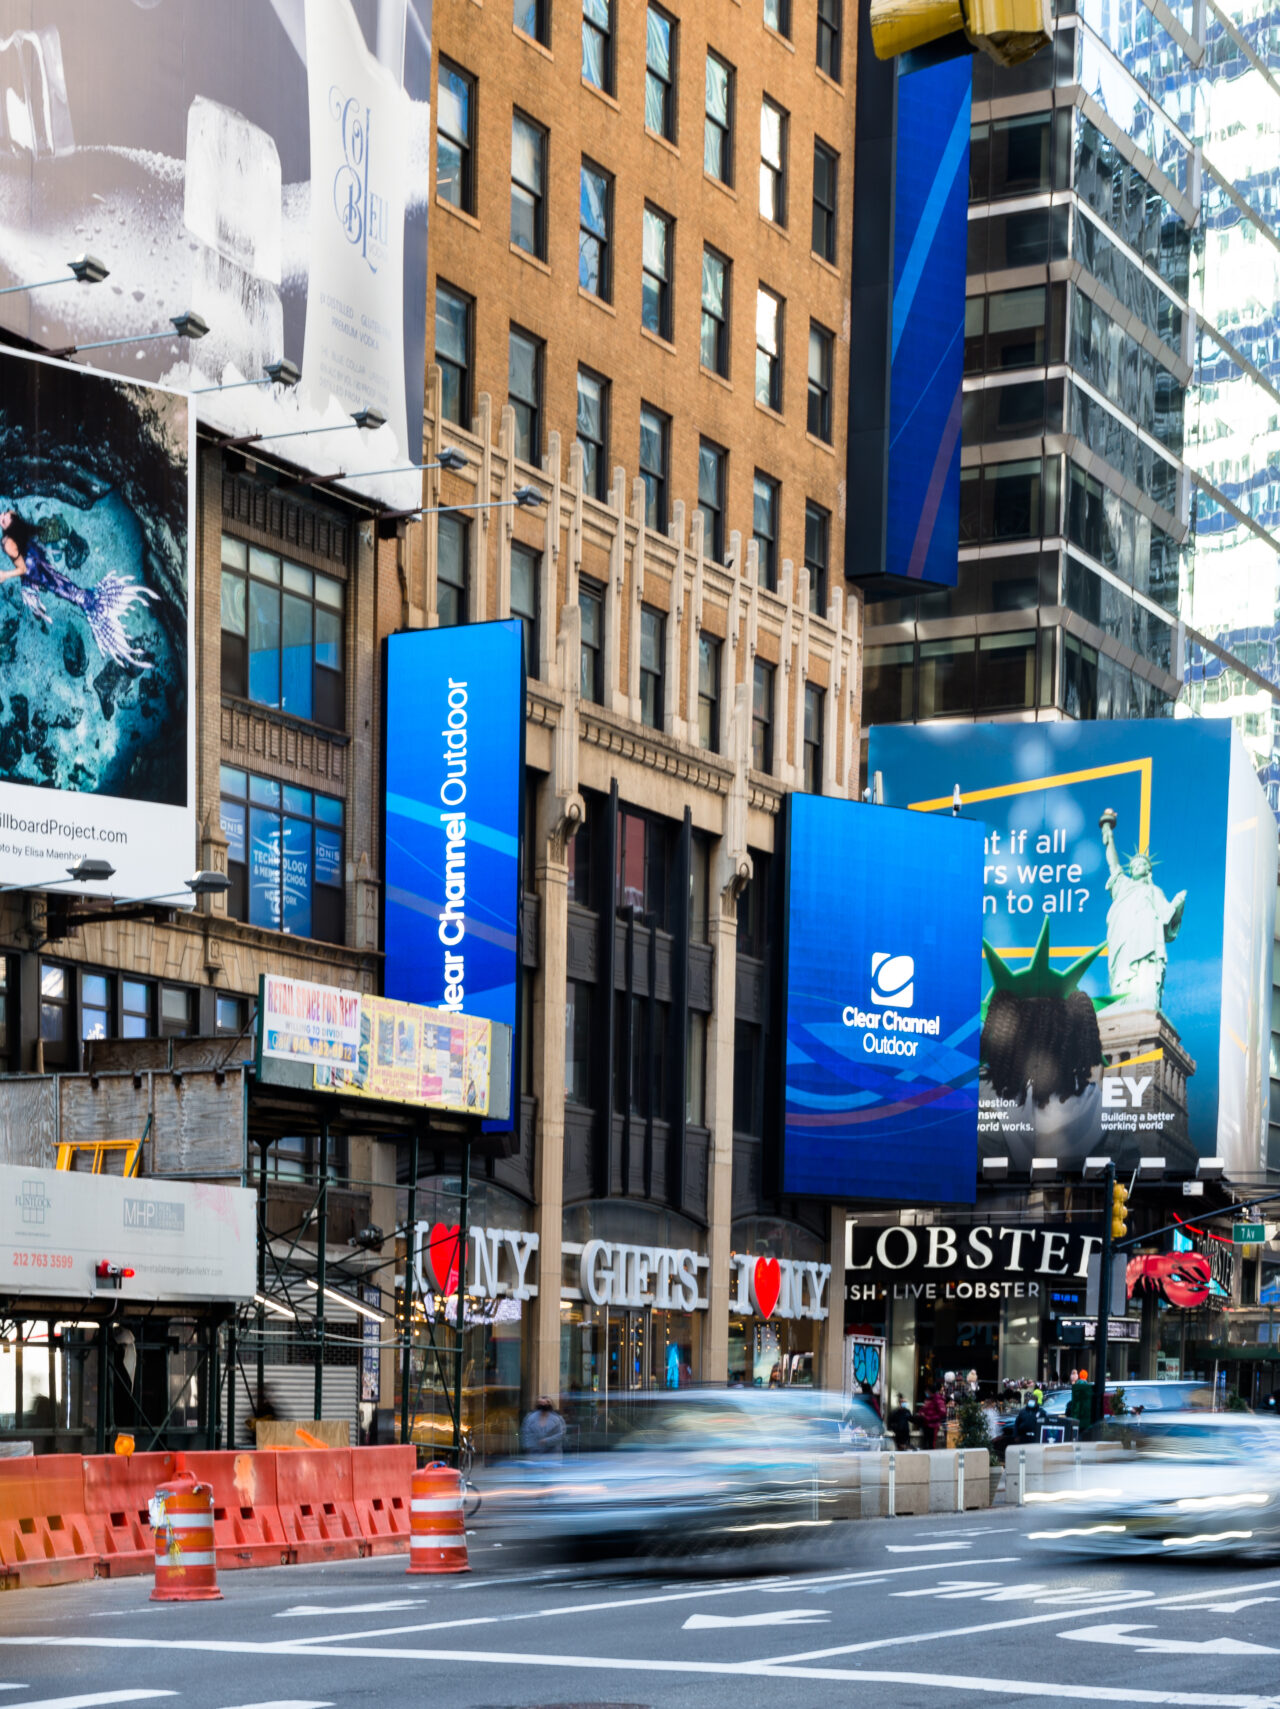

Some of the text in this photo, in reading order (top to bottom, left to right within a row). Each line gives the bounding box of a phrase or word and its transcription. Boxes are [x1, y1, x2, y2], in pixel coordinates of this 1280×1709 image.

[440, 677, 468, 806] Outdoor
[12, 844, 22, 857] by
[24, 845, 44, 858] Elisa
[1010, 829, 1028, 855] if
[1035, 828, 1067, 855] all
[316, 846, 340, 862] IONIS
[283, 872, 308, 888] SCHOOL
[438, 812, 466, 946] Channel
[1017, 863, 1083, 884] were
[1006, 889, 1033, 914] to
[1041, 888, 1090, 914] all?
[437, 951, 464, 1014] lear
[267, 980, 295, 1017] RETAIL
[296, 985, 321, 1022] SPACE
[322, 991, 338, 1025] FOR
[339, 994, 358, 1030] RENT
[312, 1025, 321, 1036] TO
[842, 1005, 940, 1036] Clear Channel
[862, 1032, 919, 1057] Outdoor
[978, 1097, 1018, 1109] uestion.
[1101, 1076, 1153, 1108] EY
[978, 1109, 1010, 1120] nswer.
[1100, 1120, 1164, 1132] working world
[1101, 1112, 1175, 1123] Building a better
[1001, 1121, 1035, 1132] works.
[124, 1200, 155, 1227] MHP
[1241, 1228, 1256, 1240] 7 Av
[12, 1252, 74, 1269] 212 763 3599
[468, 1225, 539, 1300] NY
[580, 1238, 699, 1313] GIFTS
[732, 1254, 832, 1321] I NY
[893, 1283, 937, 1299] LIVE
[945, 1281, 1040, 1299] LOBSTER
